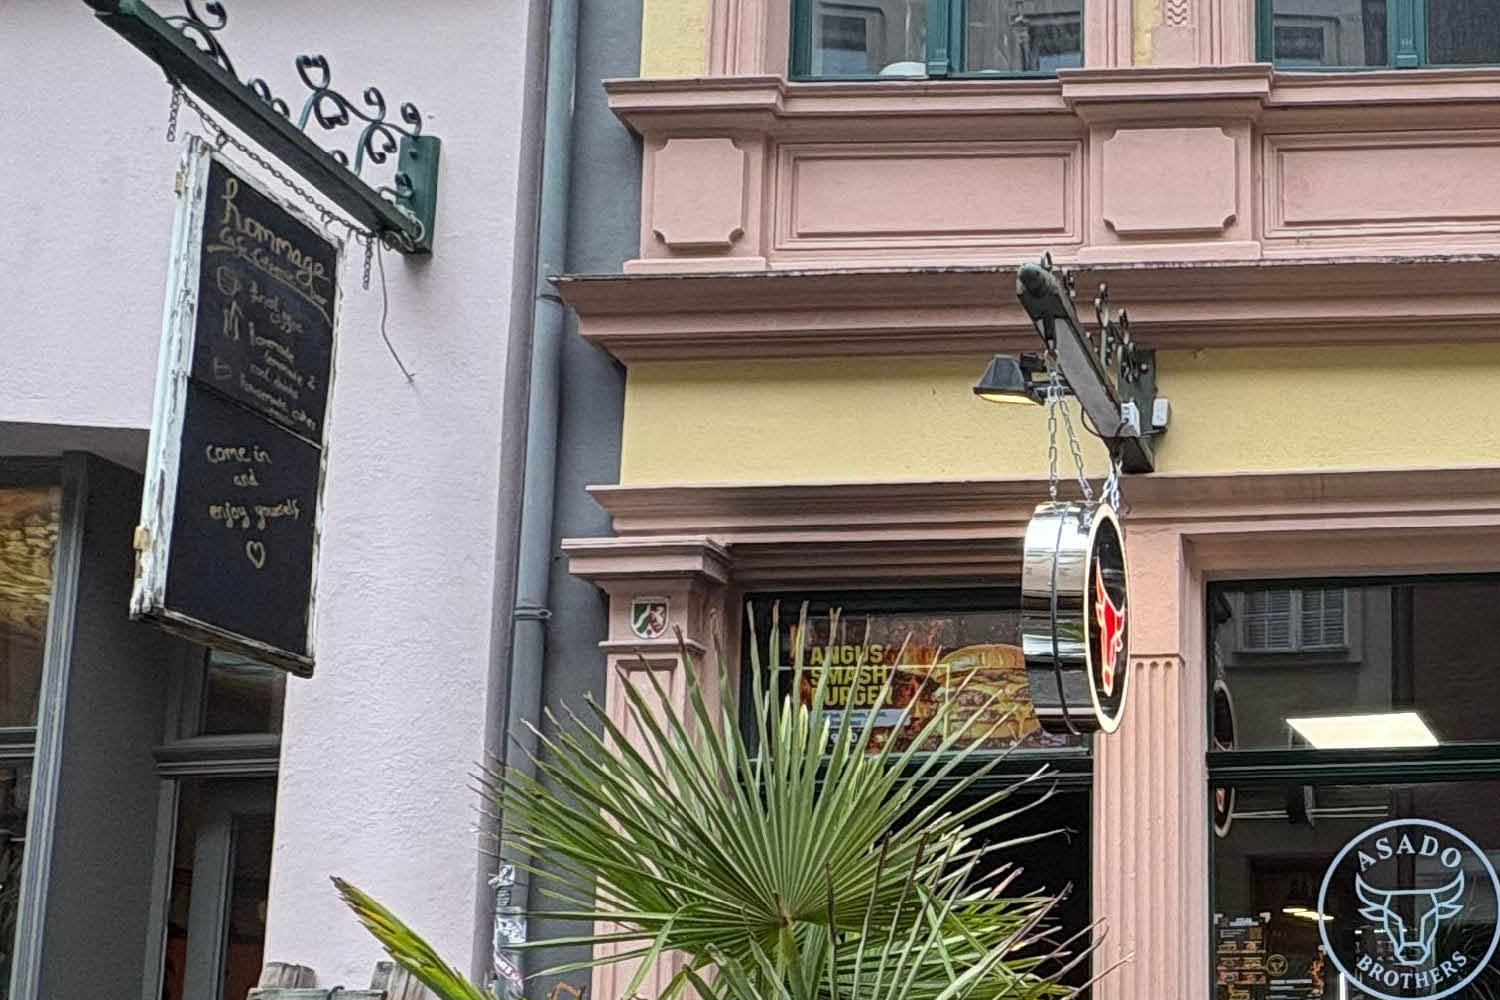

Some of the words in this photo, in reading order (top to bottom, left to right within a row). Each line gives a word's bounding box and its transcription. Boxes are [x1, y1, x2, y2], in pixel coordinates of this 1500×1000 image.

[206, 444, 251, 463] come
[254, 445, 272, 464] in
[233, 468, 259, 487] and
[209, 502, 250, 528] enjoy
[254, 499, 300, 530] yourself
[1358, 834, 1461, 871] ASADO
[1356, 951, 1467, 989] BROTHERS
